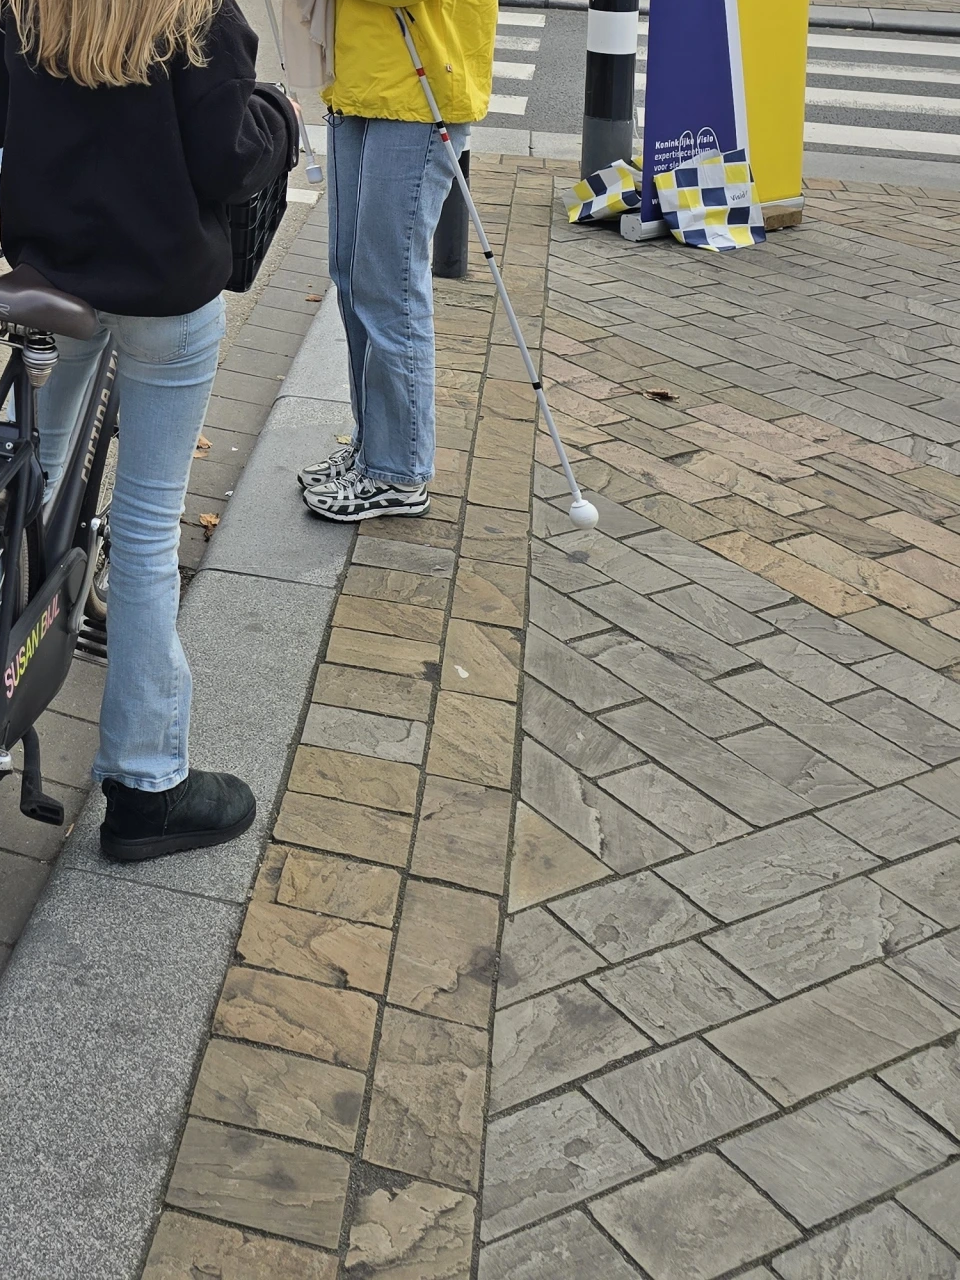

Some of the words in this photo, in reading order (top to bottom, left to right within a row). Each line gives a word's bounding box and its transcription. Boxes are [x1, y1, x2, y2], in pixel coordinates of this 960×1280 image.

[655, 137, 695, 150] Koninklijke
[653, 163, 669, 172] voor
[4, 622, 40, 698] SUSAN
[40, 593, 60, 640] BIJL
